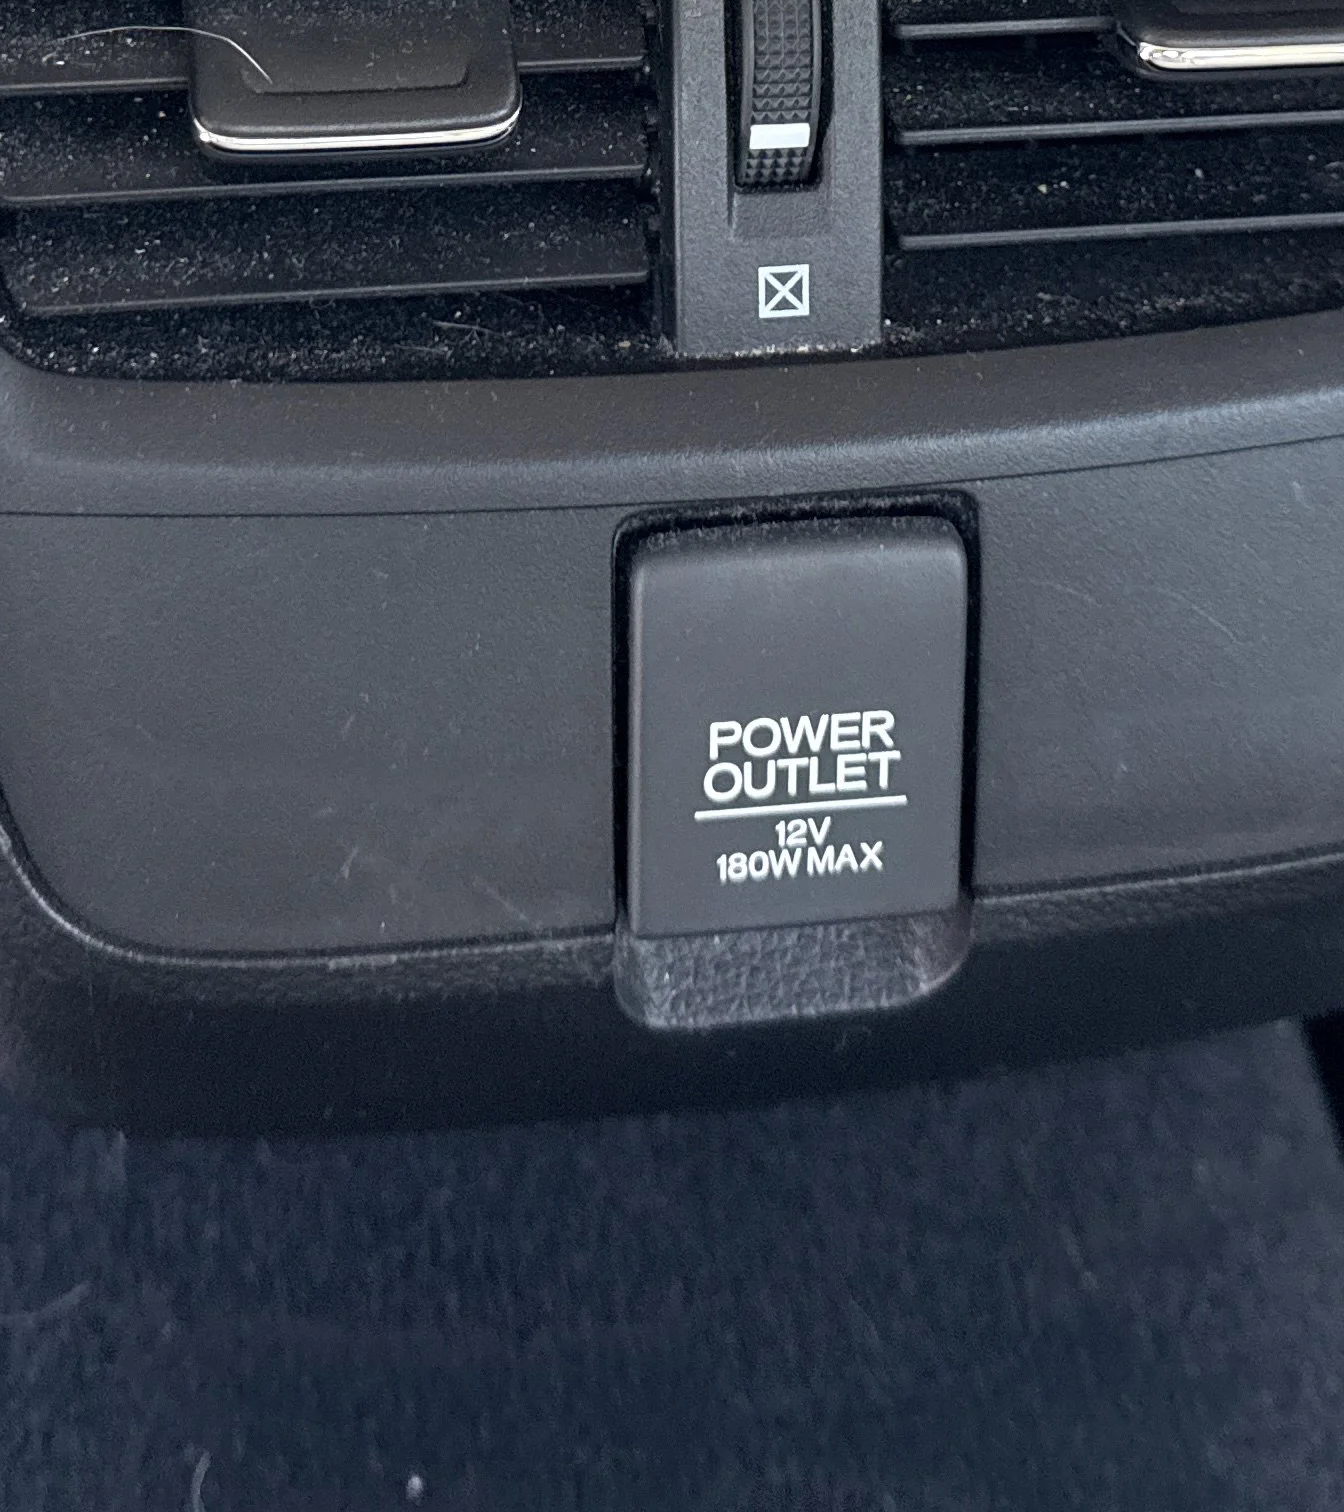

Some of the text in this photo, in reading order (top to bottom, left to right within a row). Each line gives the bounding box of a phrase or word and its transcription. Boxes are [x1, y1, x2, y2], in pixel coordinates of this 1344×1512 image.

[709, 709, 895, 761] POWER
[703, 749, 902, 803] OUTLET
[775, 815, 832, 848] 12V
[716, 840, 884, 885] 180W MAX
